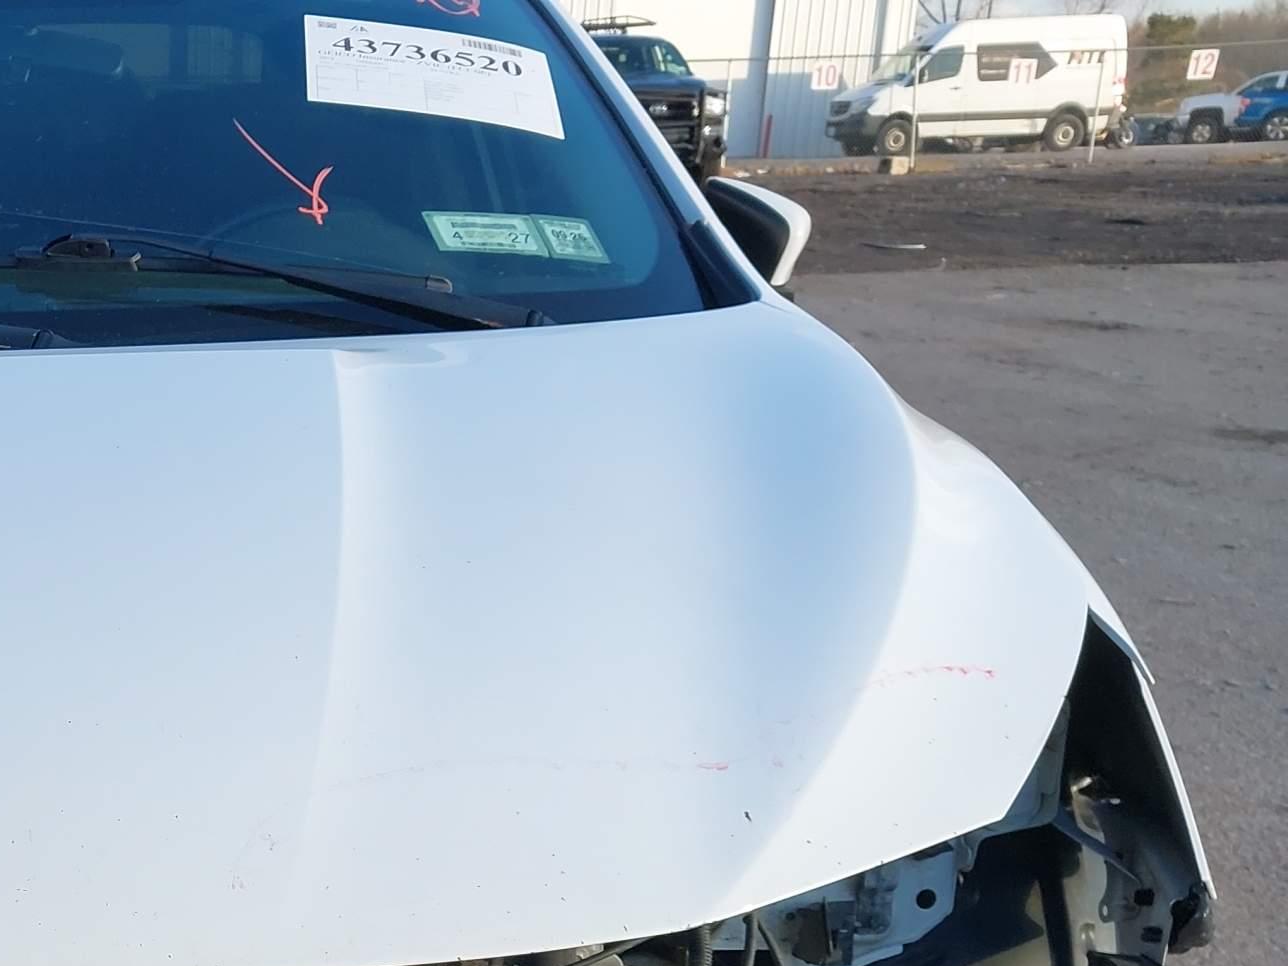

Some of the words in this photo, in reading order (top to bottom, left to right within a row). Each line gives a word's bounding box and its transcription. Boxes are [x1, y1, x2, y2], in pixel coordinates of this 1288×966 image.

[332, 37, 522, 77] 43736520
[1193, 53, 1215, 76] 12
[815, 64, 838, 87] 10
[1014, 62, 1033, 84] 11
[508, 232, 531, 244] 27
